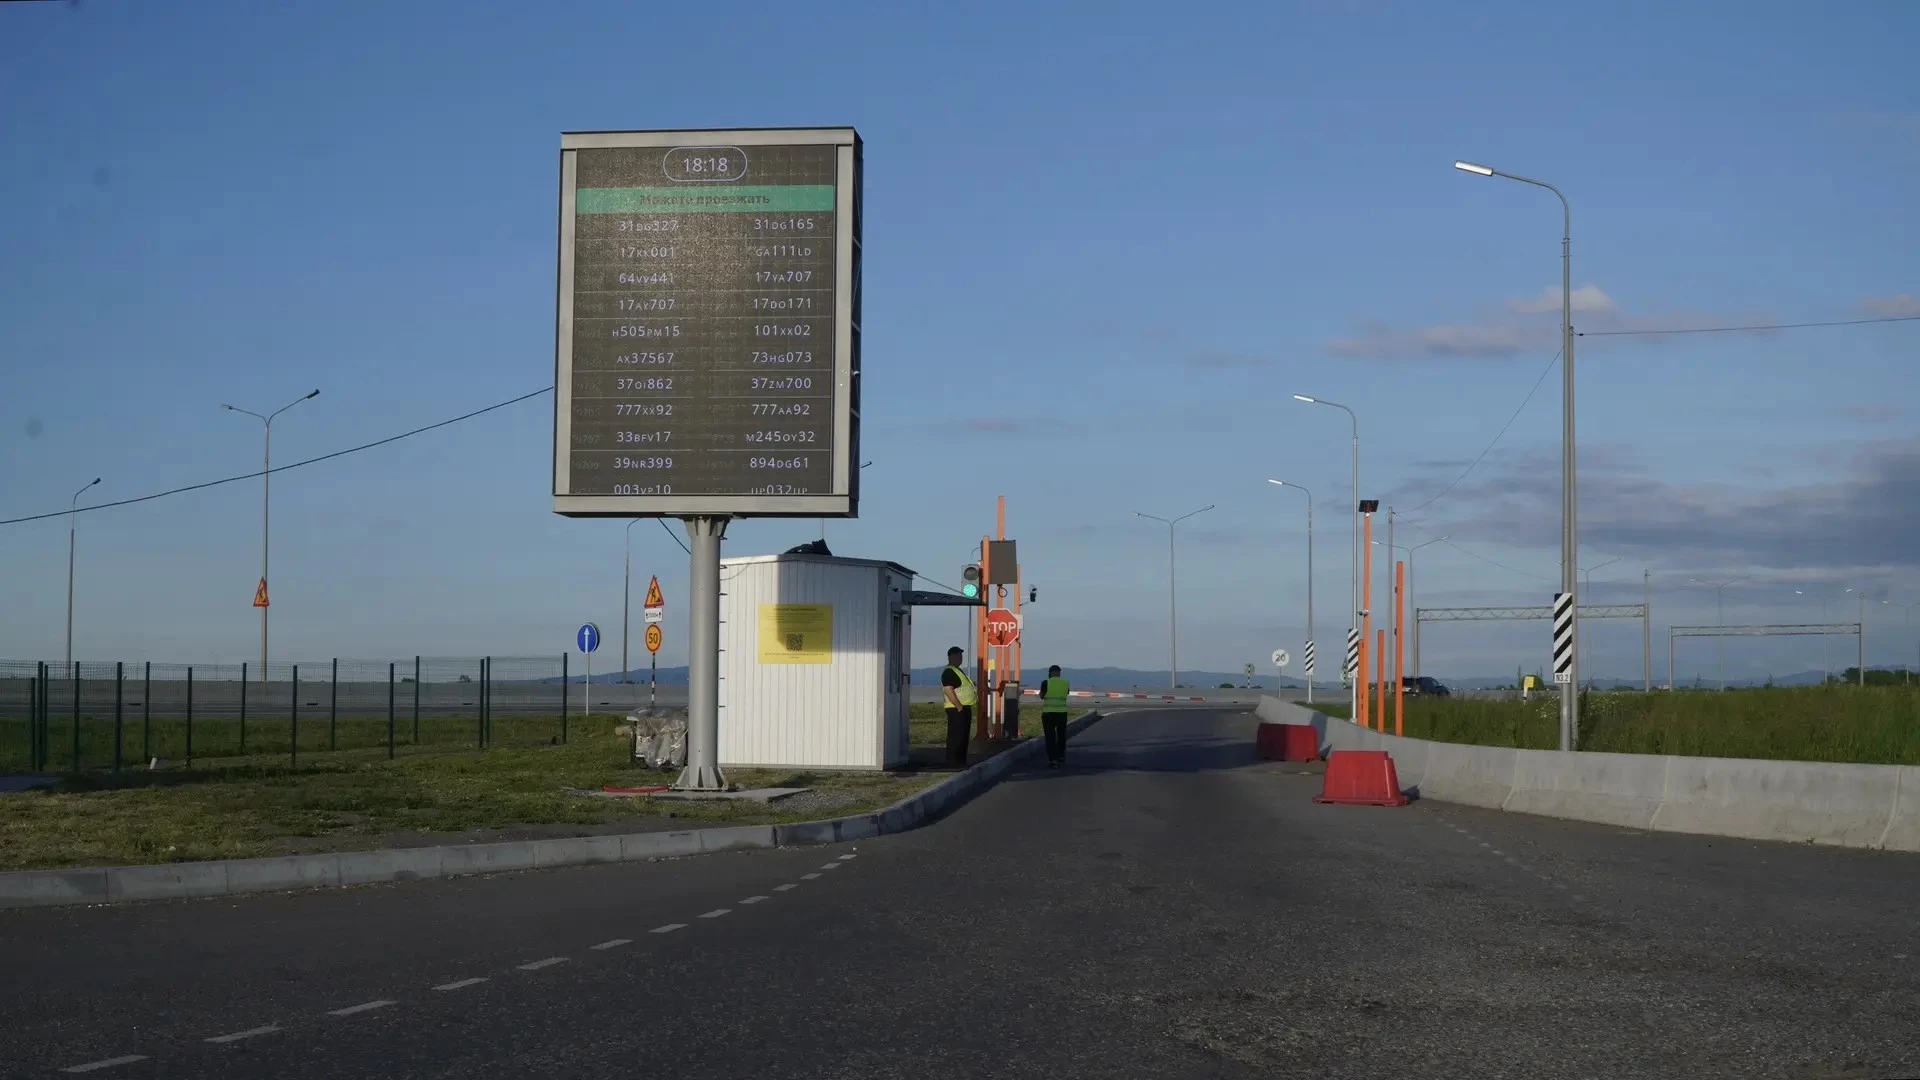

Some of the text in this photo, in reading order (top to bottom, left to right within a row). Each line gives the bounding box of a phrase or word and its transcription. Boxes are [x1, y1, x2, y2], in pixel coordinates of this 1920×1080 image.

[683, 157, 728, 173] 18:18
[754, 218, 814, 230] 31DG165
[755, 245, 812, 257] GA111LD
[612, 325, 680, 337] H505PM15
[754, 324, 811, 336] 101XX02
[616, 352, 674, 364] AX37567
[752, 351, 812, 363] 73HG073
[751, 377, 812, 389] 37ZM700
[616, 404, 673, 416] 777XX92
[752, 403, 810, 415] 777AA92
[616, 431, 671, 443] 33BFV17
[614, 457, 673, 469] 39NR399
[750, 457, 808, 468] 894DG61
[988, 621, 1017, 634] TOP
[648, 632, 659, 644] 50
[1275, 653, 1286, 662] 20
